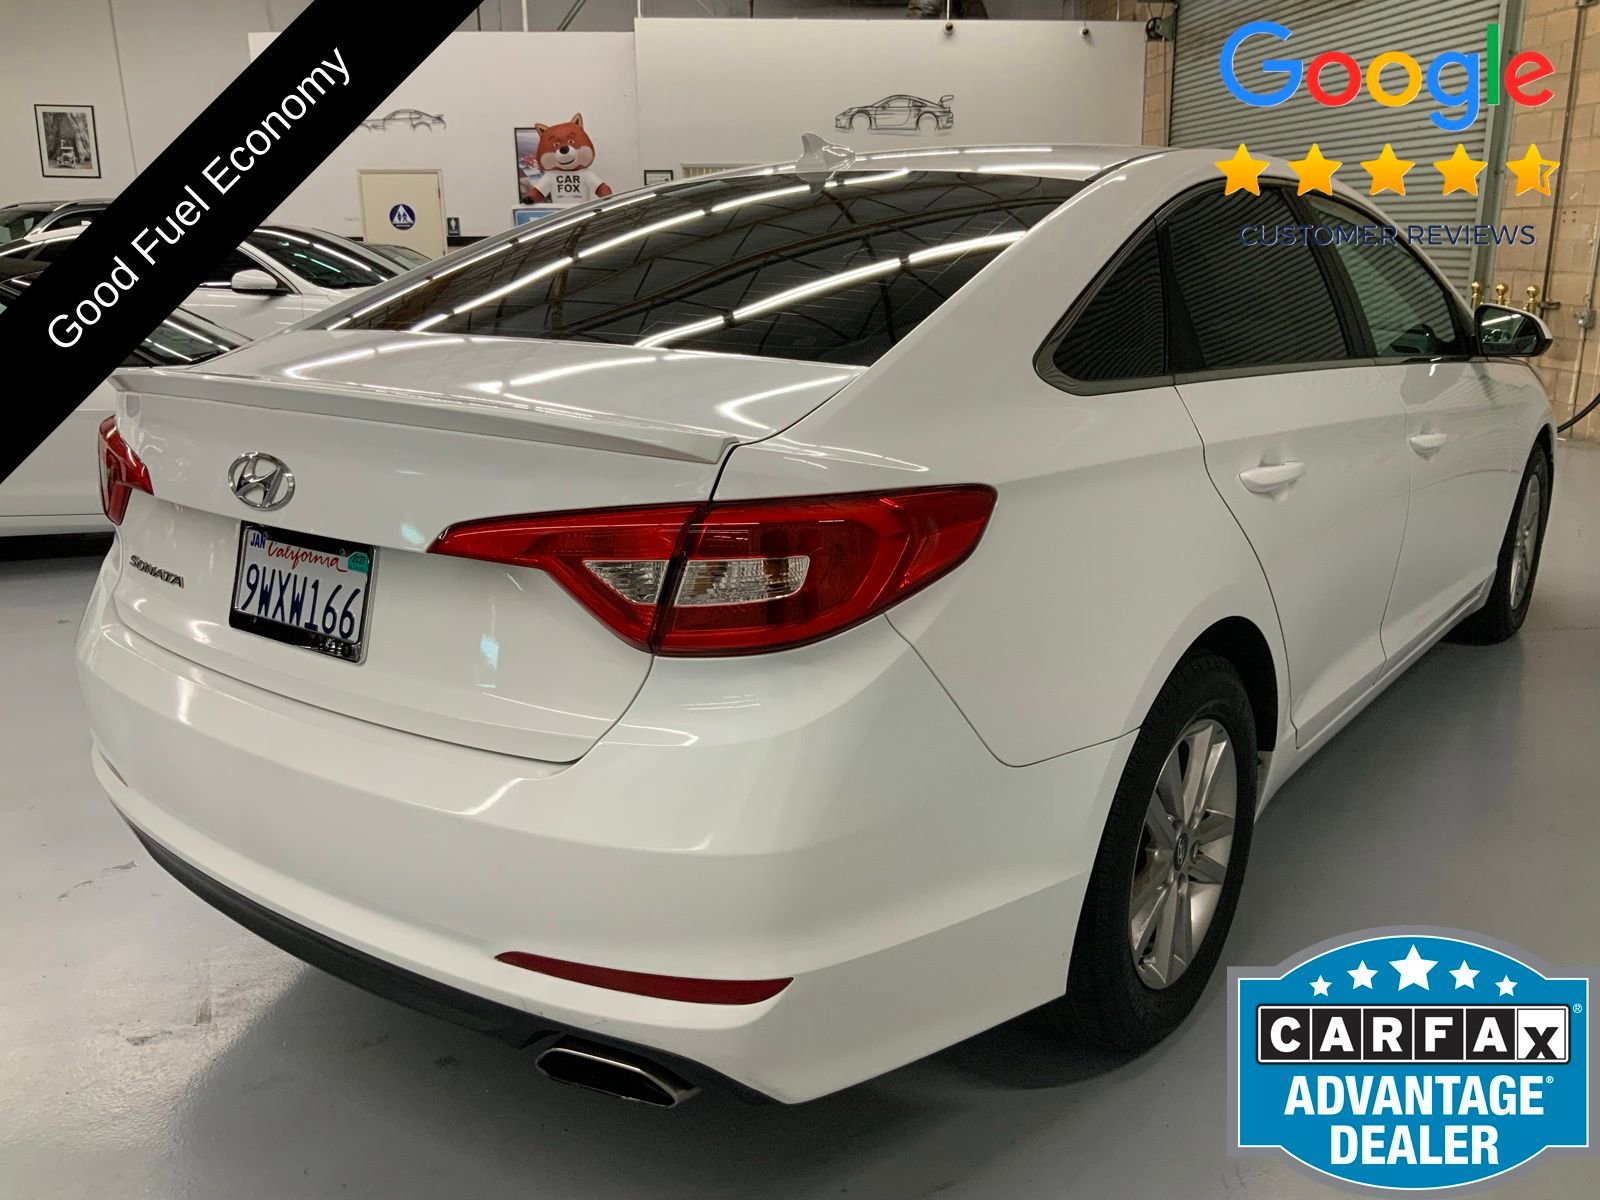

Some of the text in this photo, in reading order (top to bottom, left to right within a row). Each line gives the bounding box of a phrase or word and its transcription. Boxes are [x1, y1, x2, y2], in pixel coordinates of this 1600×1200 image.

[556, 175, 580, 183] CAR
[557, 184, 580, 192] FOX
[250, 532, 266, 549] JAN
[267, 541, 349, 573] California
[128, 554, 185, 589] SONATA
[242, 563, 362, 640] 9WXW166
